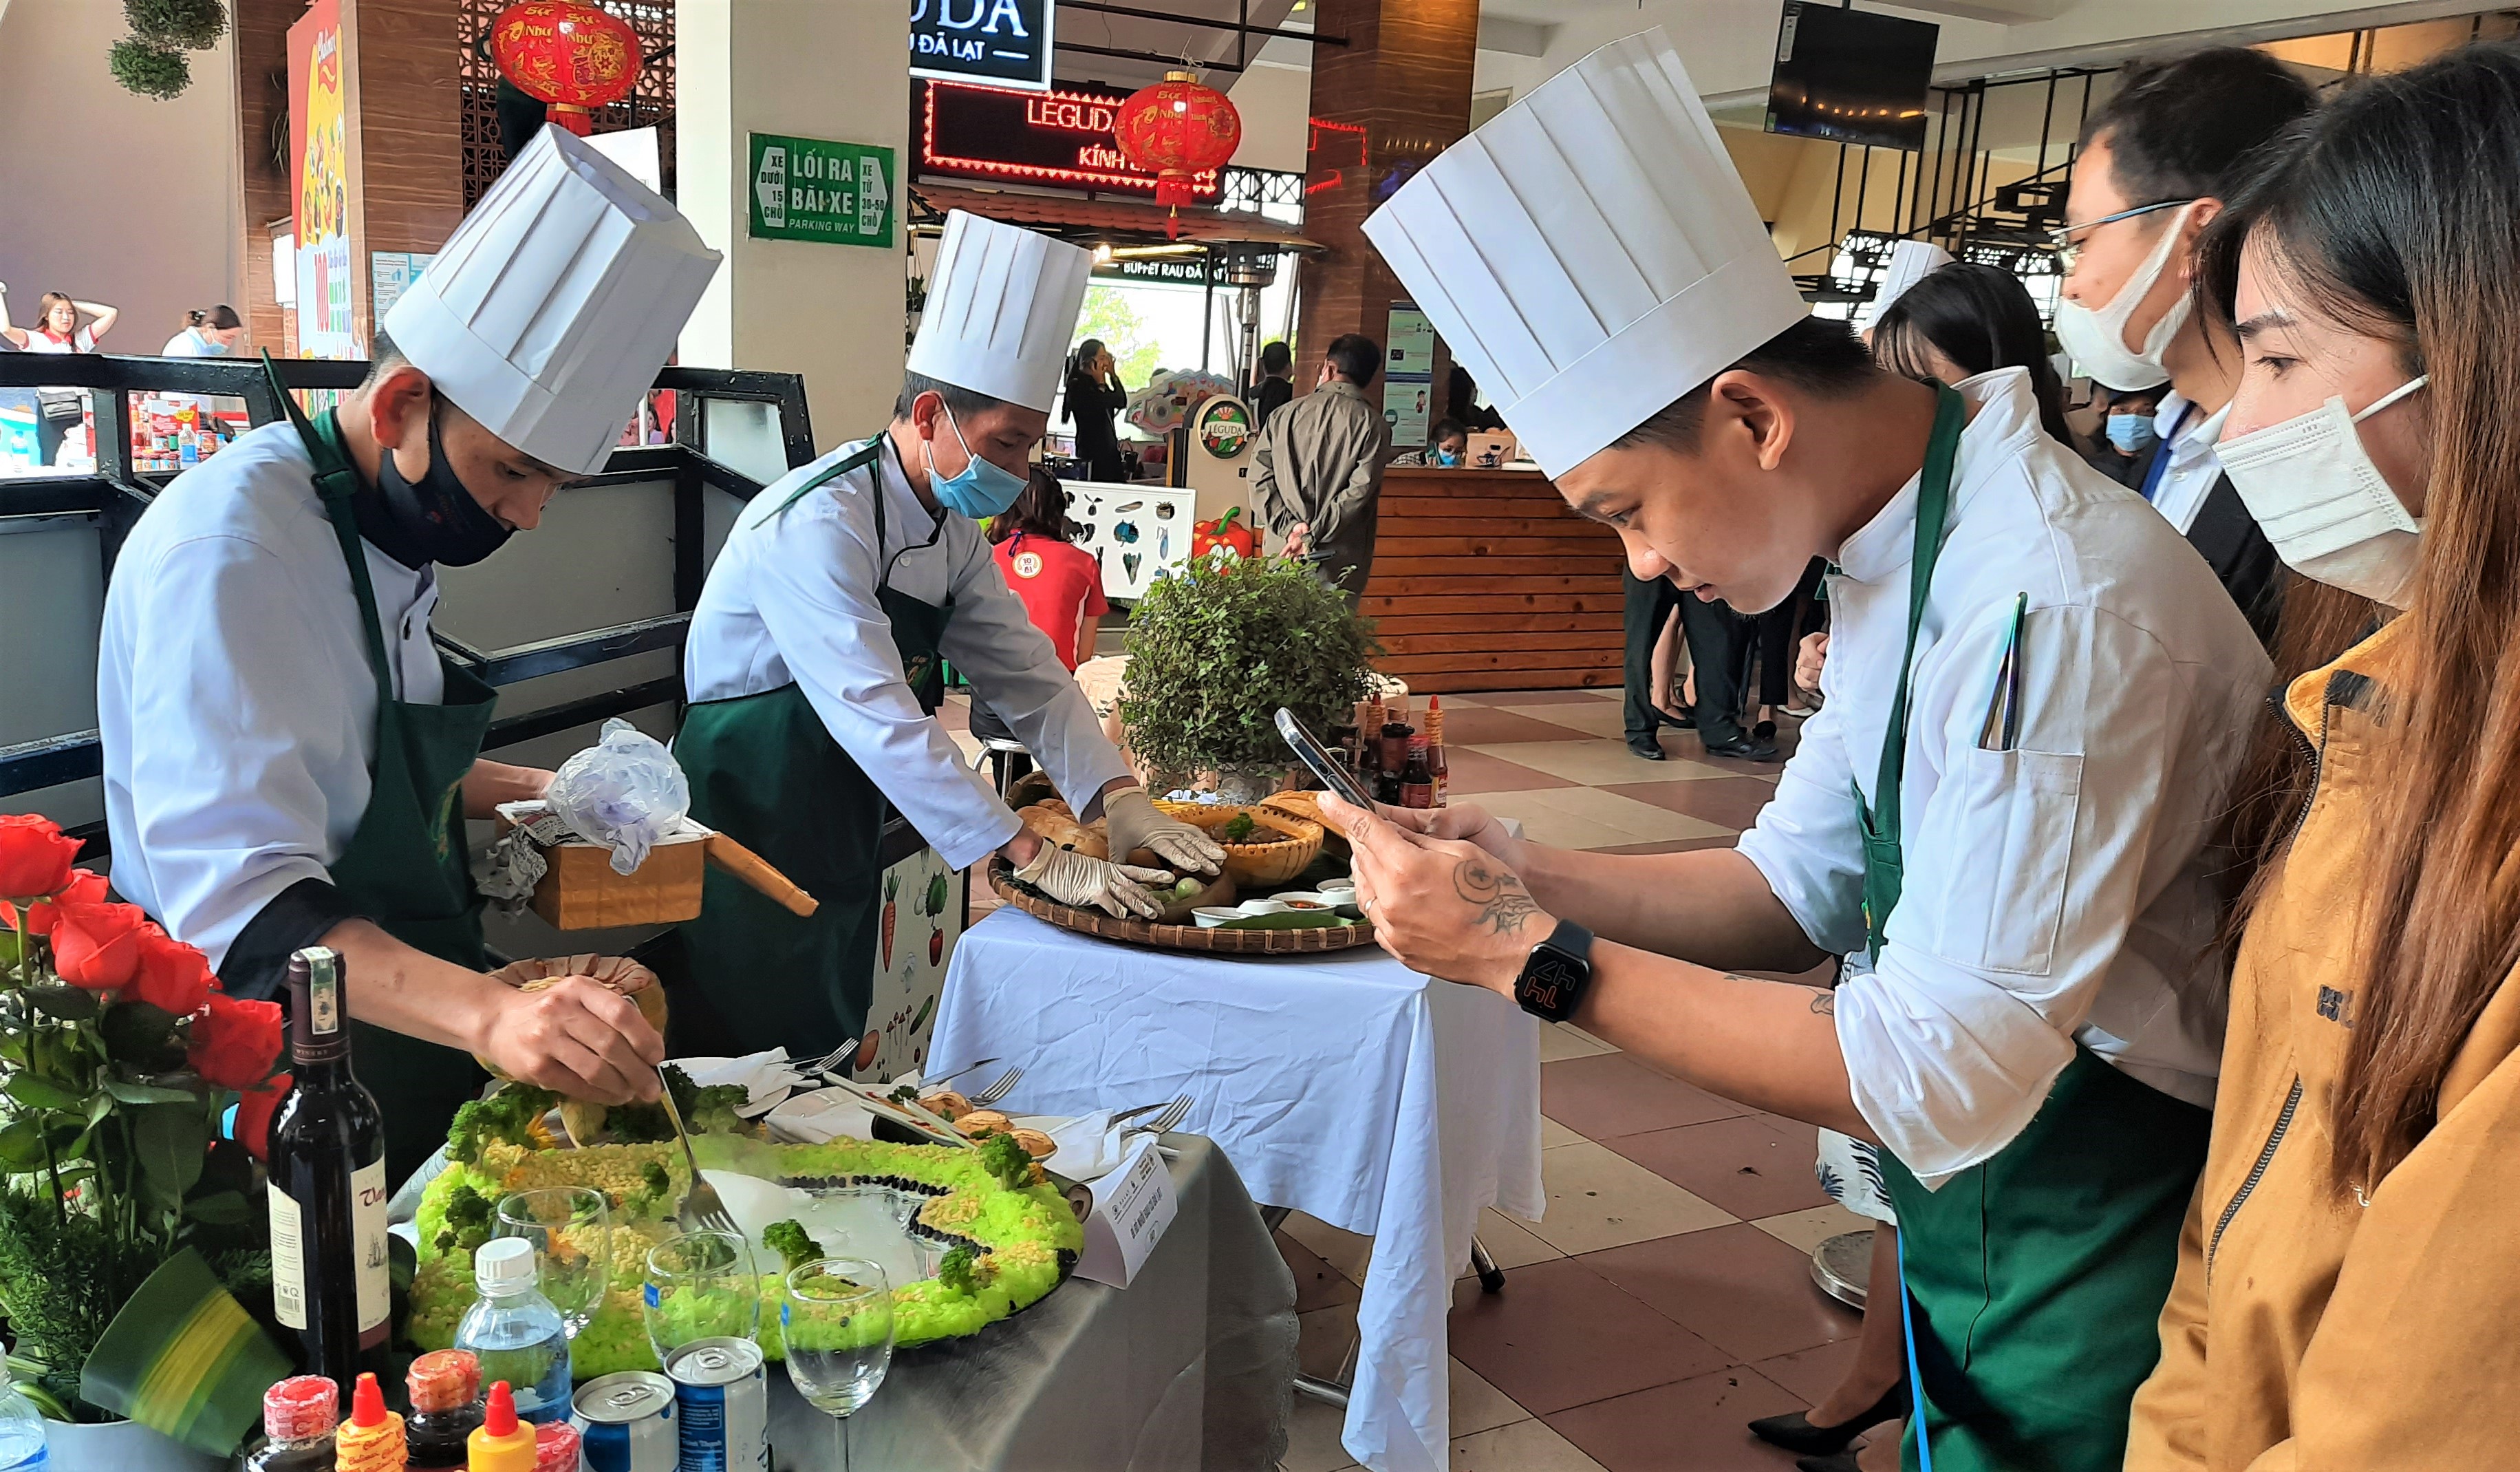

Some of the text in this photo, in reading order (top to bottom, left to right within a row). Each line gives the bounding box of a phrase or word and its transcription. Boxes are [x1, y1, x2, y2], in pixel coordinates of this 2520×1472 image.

[953, 39, 985, 62] LẠT
[1027, 98, 1115, 132] LEGUD
[771, 155, 784, 168] XE
[1079, 143, 1126, 170] KÍNH
[793, 148, 853, 182] LỐI RA
[862, 164, 873, 177] XE
[772, 190, 783, 202] 15
[829, 191, 853, 215] XE
[862, 198, 885, 211] 30-50
[788, 218, 854, 233] PARKING WAY
[1161, 264, 1184, 277] RAU
